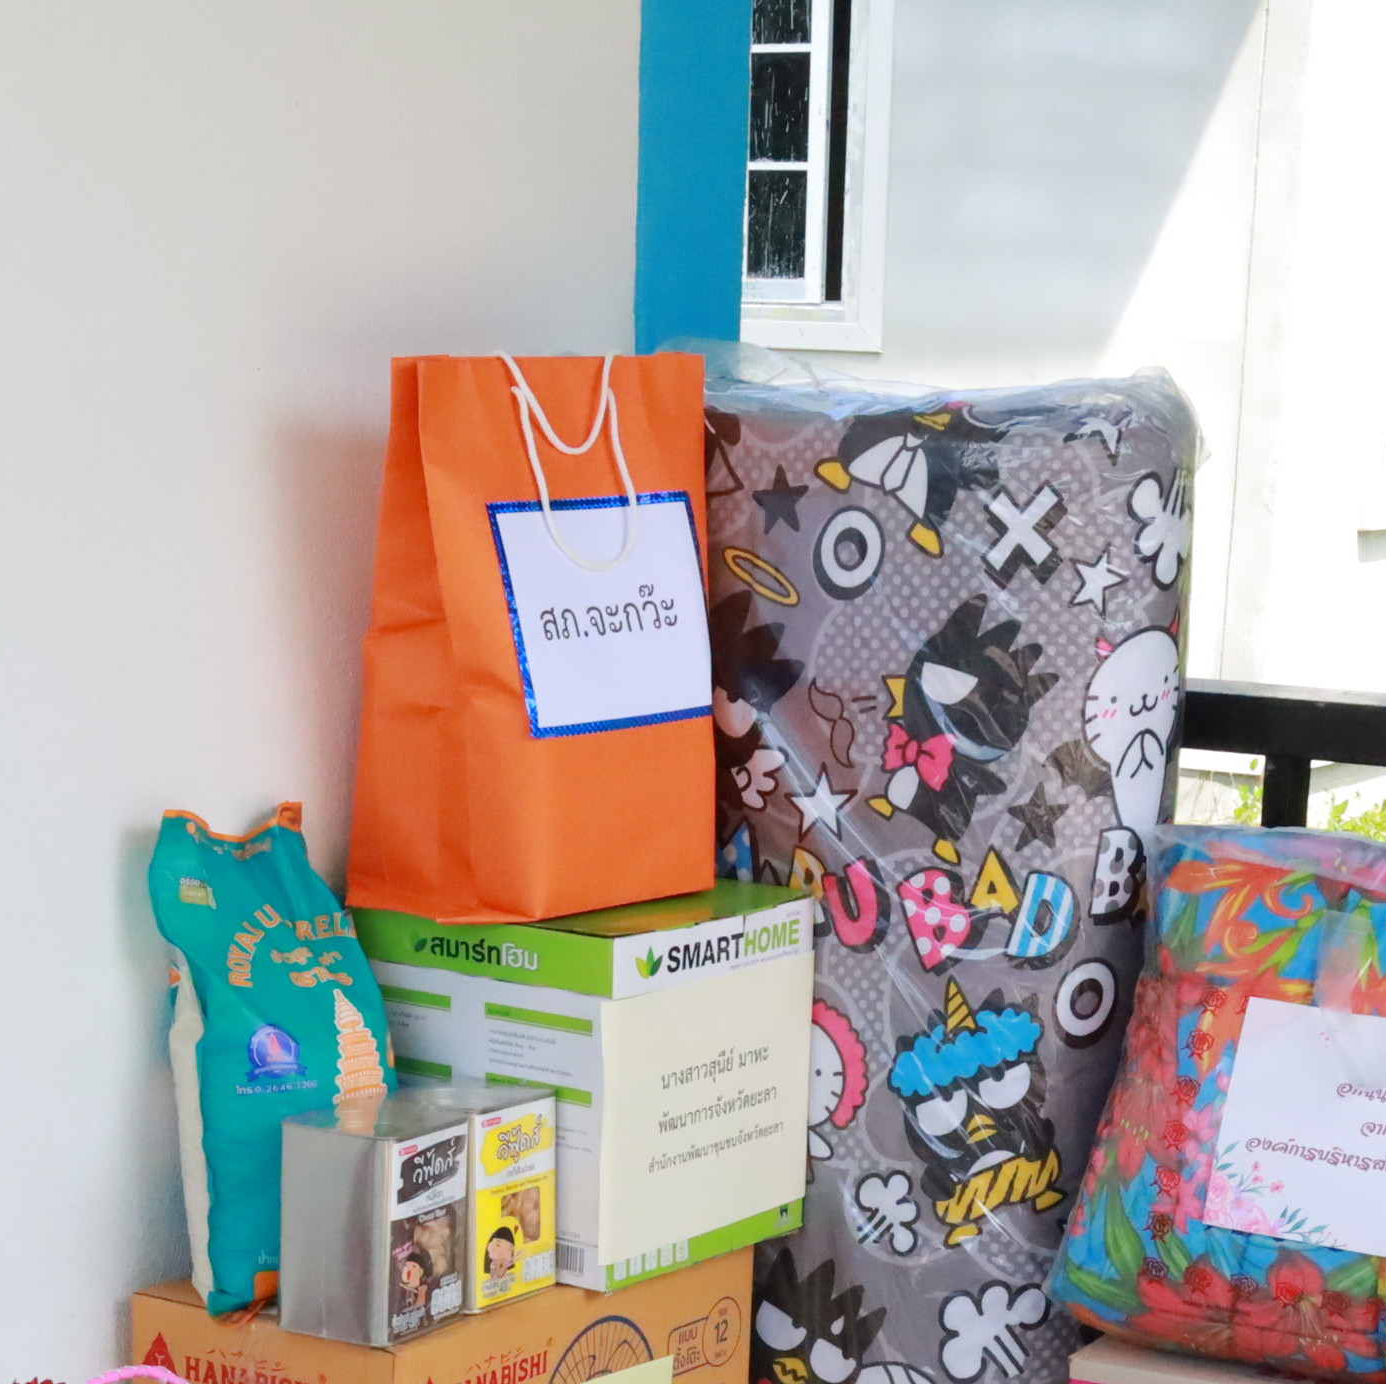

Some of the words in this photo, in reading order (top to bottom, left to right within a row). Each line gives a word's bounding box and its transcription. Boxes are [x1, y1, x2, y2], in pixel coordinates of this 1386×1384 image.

[540, 584, 678, 641] สภ.จะกว๊ะ
[661, 1046, 734, 1090] นางสาวสุนีย์
[738, 1045, 769, 1069] มาหะ
[658, 1085, 778, 1134] พัฒนาการจังหวัดยะลา
[648, 1120, 784, 1175] สำนักงานพัฒนาชุมชนจังหวัดยะลา
[713, 1319, 729, 1345] 12
